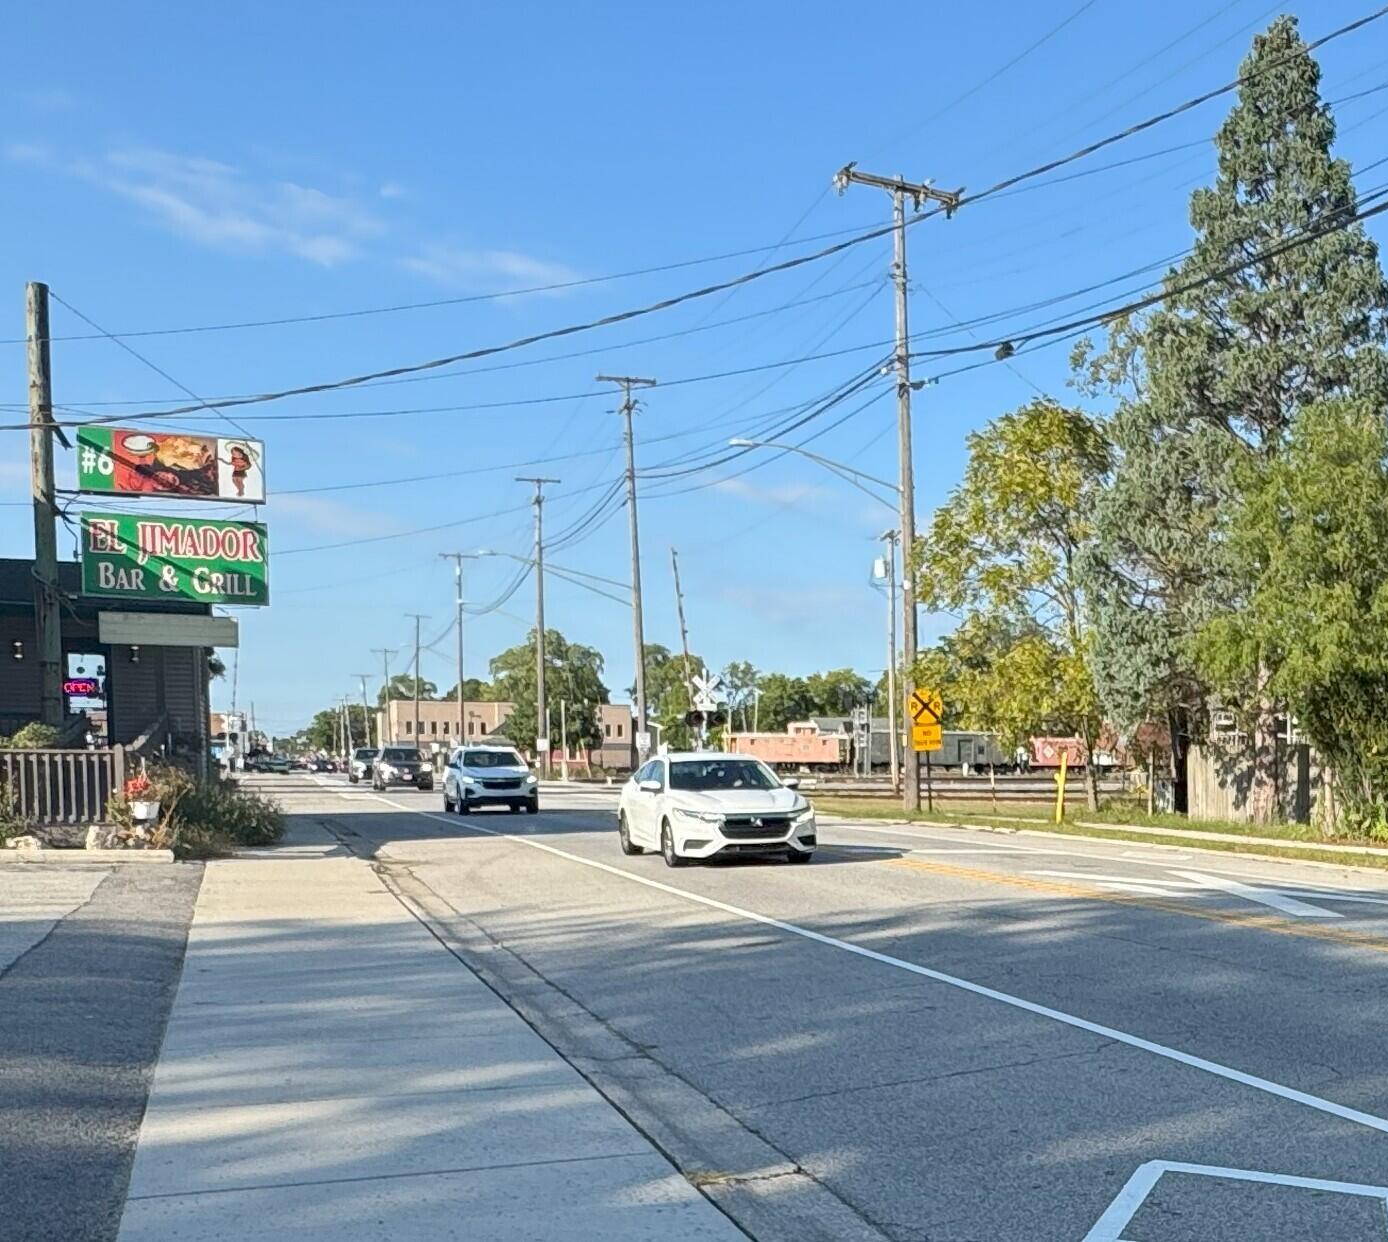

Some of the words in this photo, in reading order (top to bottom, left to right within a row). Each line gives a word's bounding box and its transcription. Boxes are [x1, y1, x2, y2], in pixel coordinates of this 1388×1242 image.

[81, 445, 114, 476] #6
[88, 519, 127, 554] EL
[137, 522, 263, 565] JIMADOR
[159, 565, 179, 592] &
[64, 682, 97, 693] OPEN
[911, 701, 918, 711] R
[933, 701, 941, 710] R
